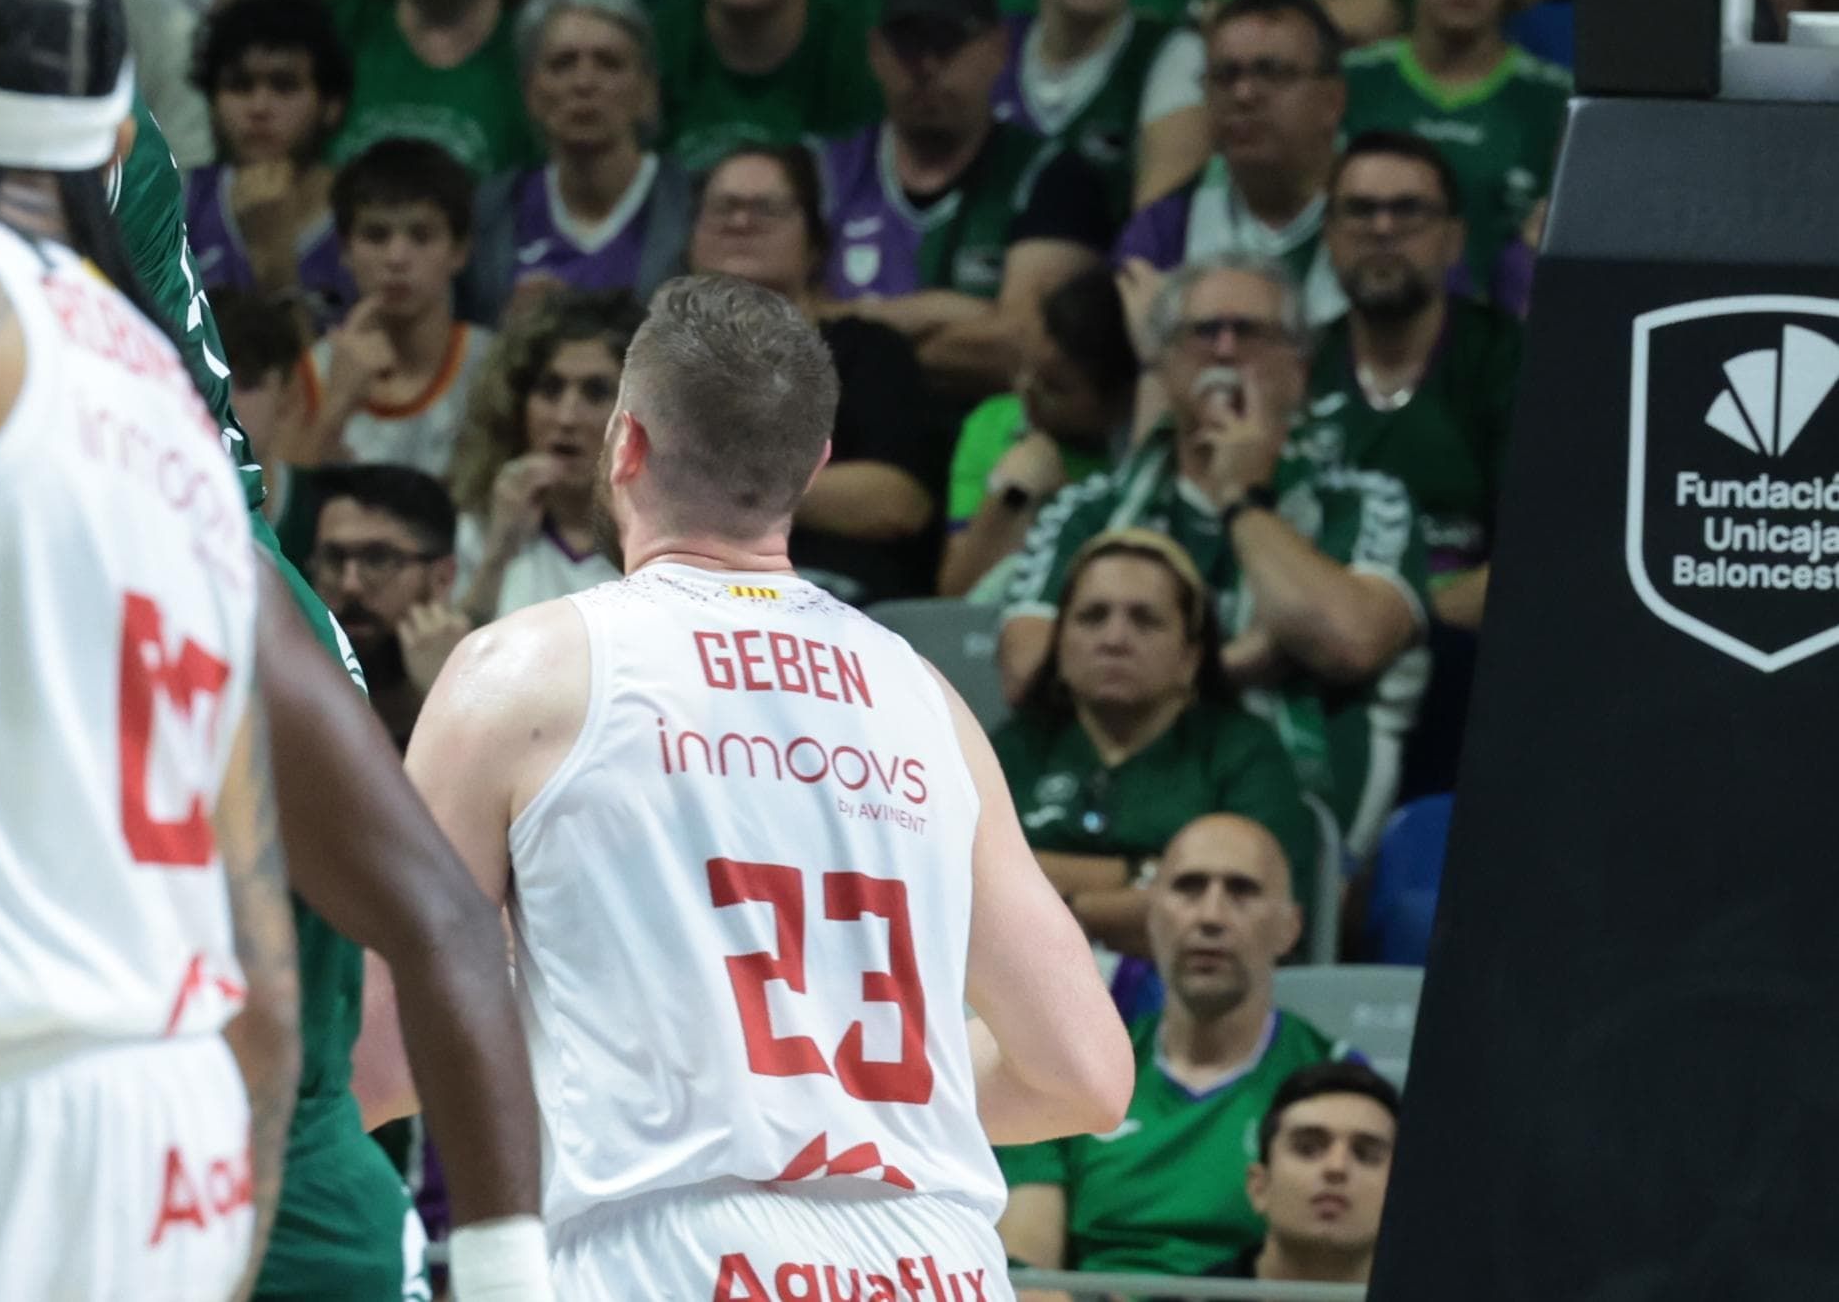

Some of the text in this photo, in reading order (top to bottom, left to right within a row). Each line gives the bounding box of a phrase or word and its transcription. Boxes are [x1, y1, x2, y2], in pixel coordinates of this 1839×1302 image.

[1703, 516, 1839, 563] Unicaja
[693, 630, 873, 708] GEBEN
[657, 717, 927, 805] inmoovs
[837, 796, 854, 819] by
[705, 857, 934, 1105] 23
